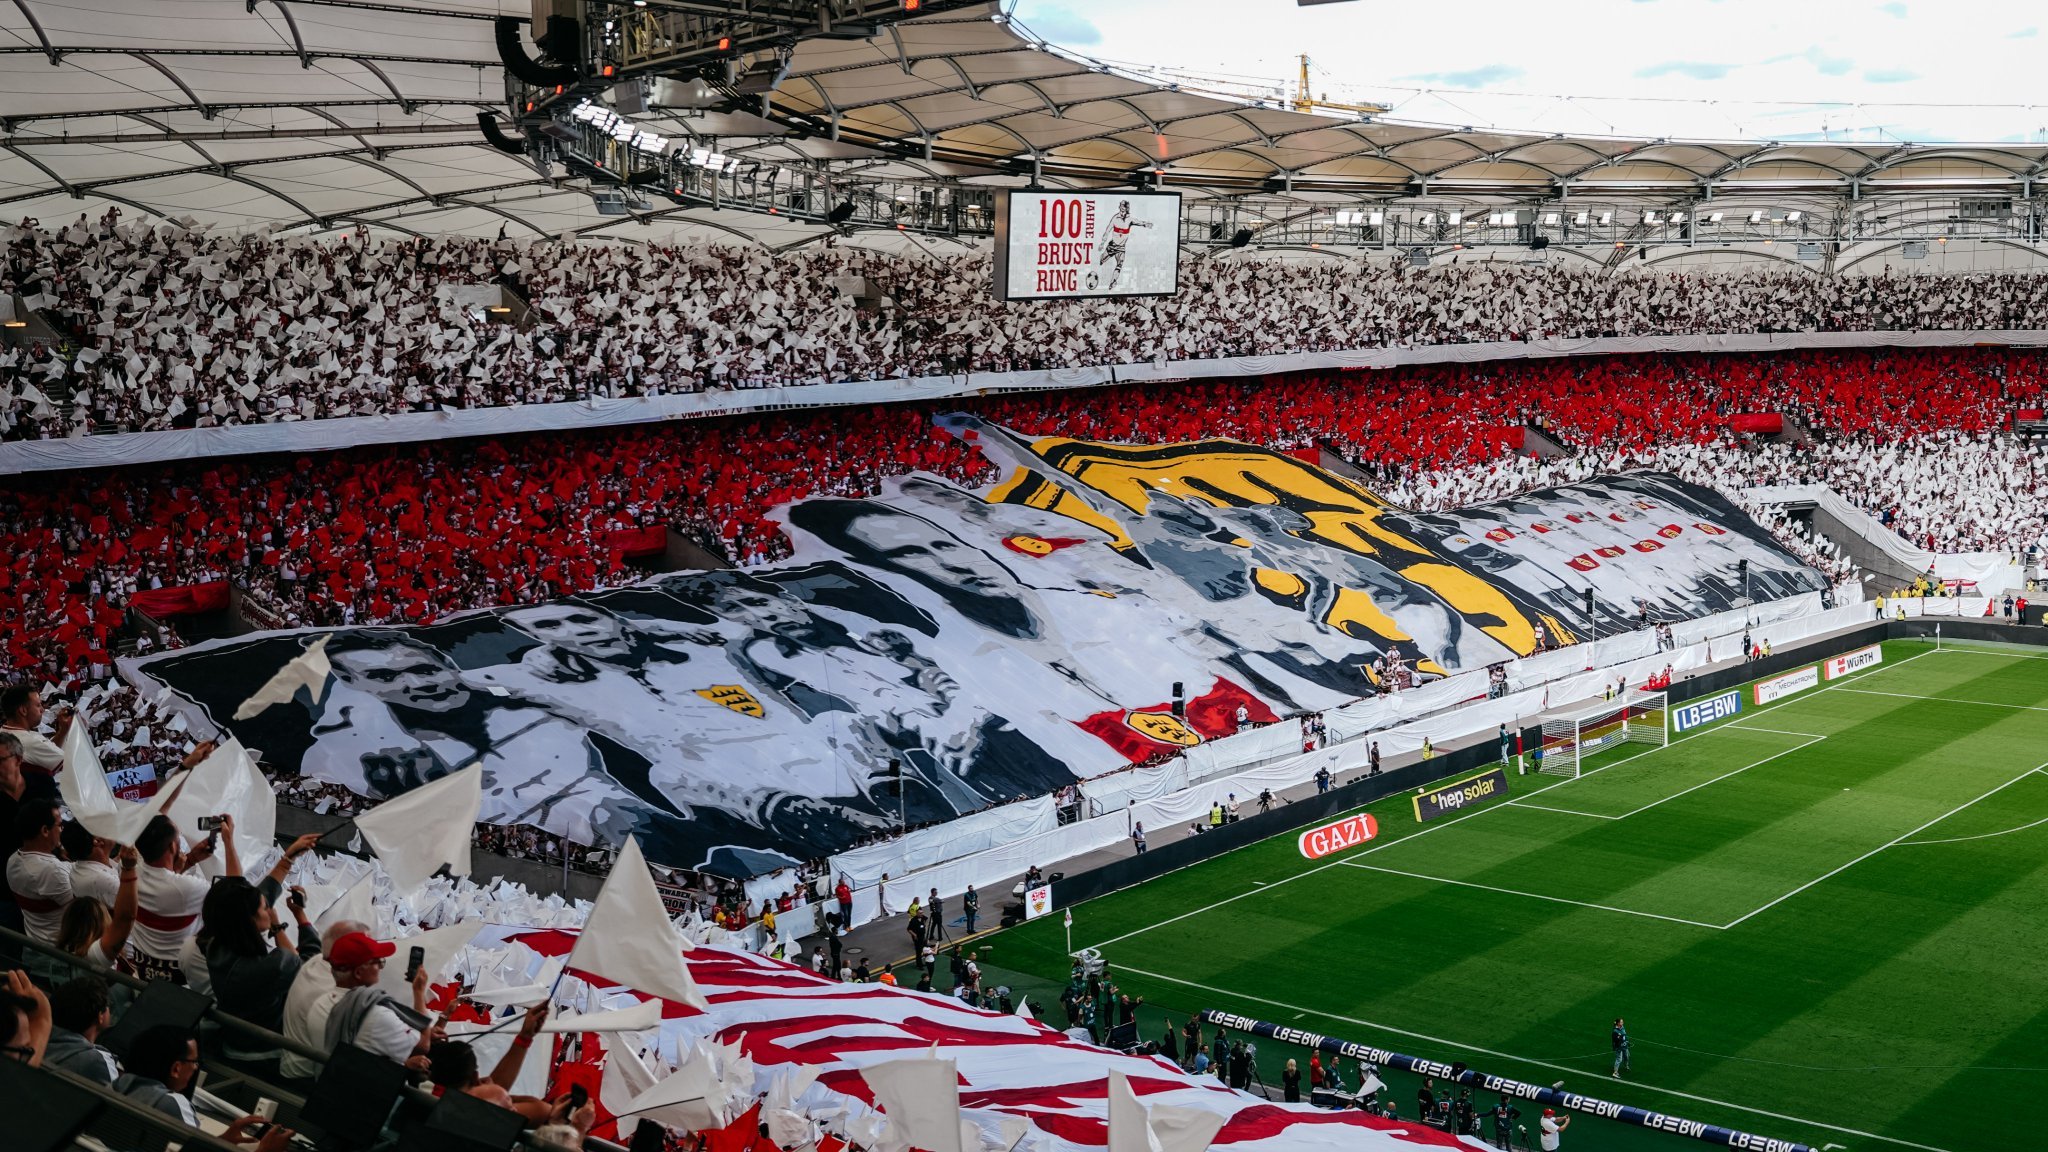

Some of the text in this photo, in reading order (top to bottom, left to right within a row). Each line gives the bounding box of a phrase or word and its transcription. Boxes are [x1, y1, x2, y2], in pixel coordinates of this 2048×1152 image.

[1038, 199, 1082, 238] 100
[1085, 199, 1095, 239] JAHRE
[1037, 242, 1093, 266] BRUST
[1036, 269, 1078, 292] RING
